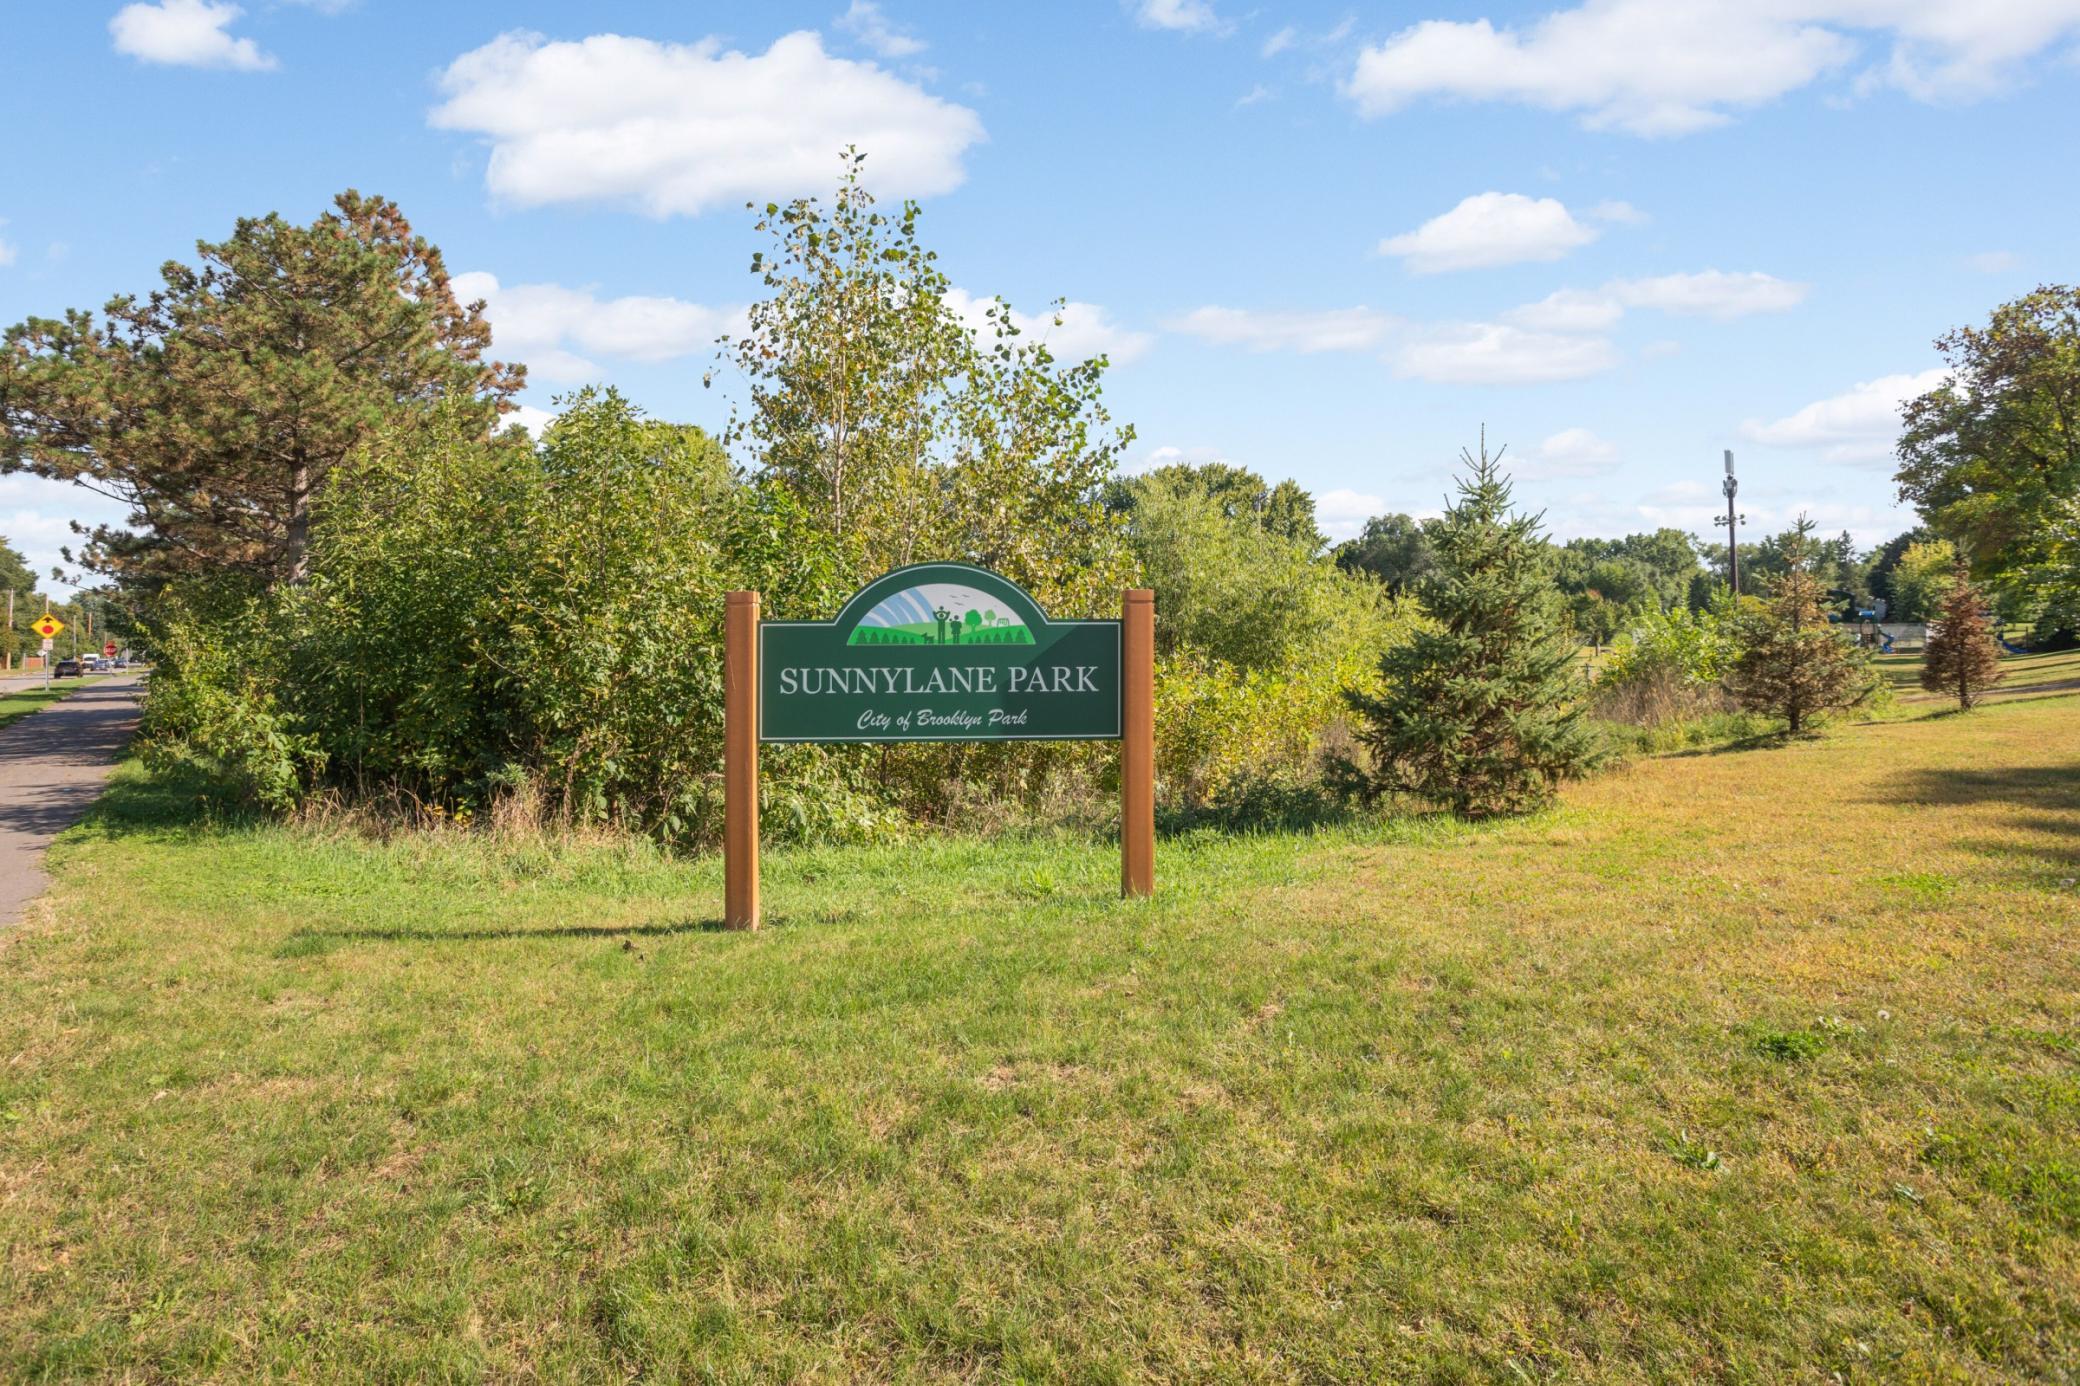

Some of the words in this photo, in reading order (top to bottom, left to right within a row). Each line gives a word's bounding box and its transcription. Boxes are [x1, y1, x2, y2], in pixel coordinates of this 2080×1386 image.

[779, 667, 997, 695] SUNNYLANE
[1007, 666, 1099, 693] PARK
[856, 709, 892, 732] City
[896, 711, 912, 732] of
[916, 708, 982, 730] Brooklyn
[988, 708, 1028, 727] Park
